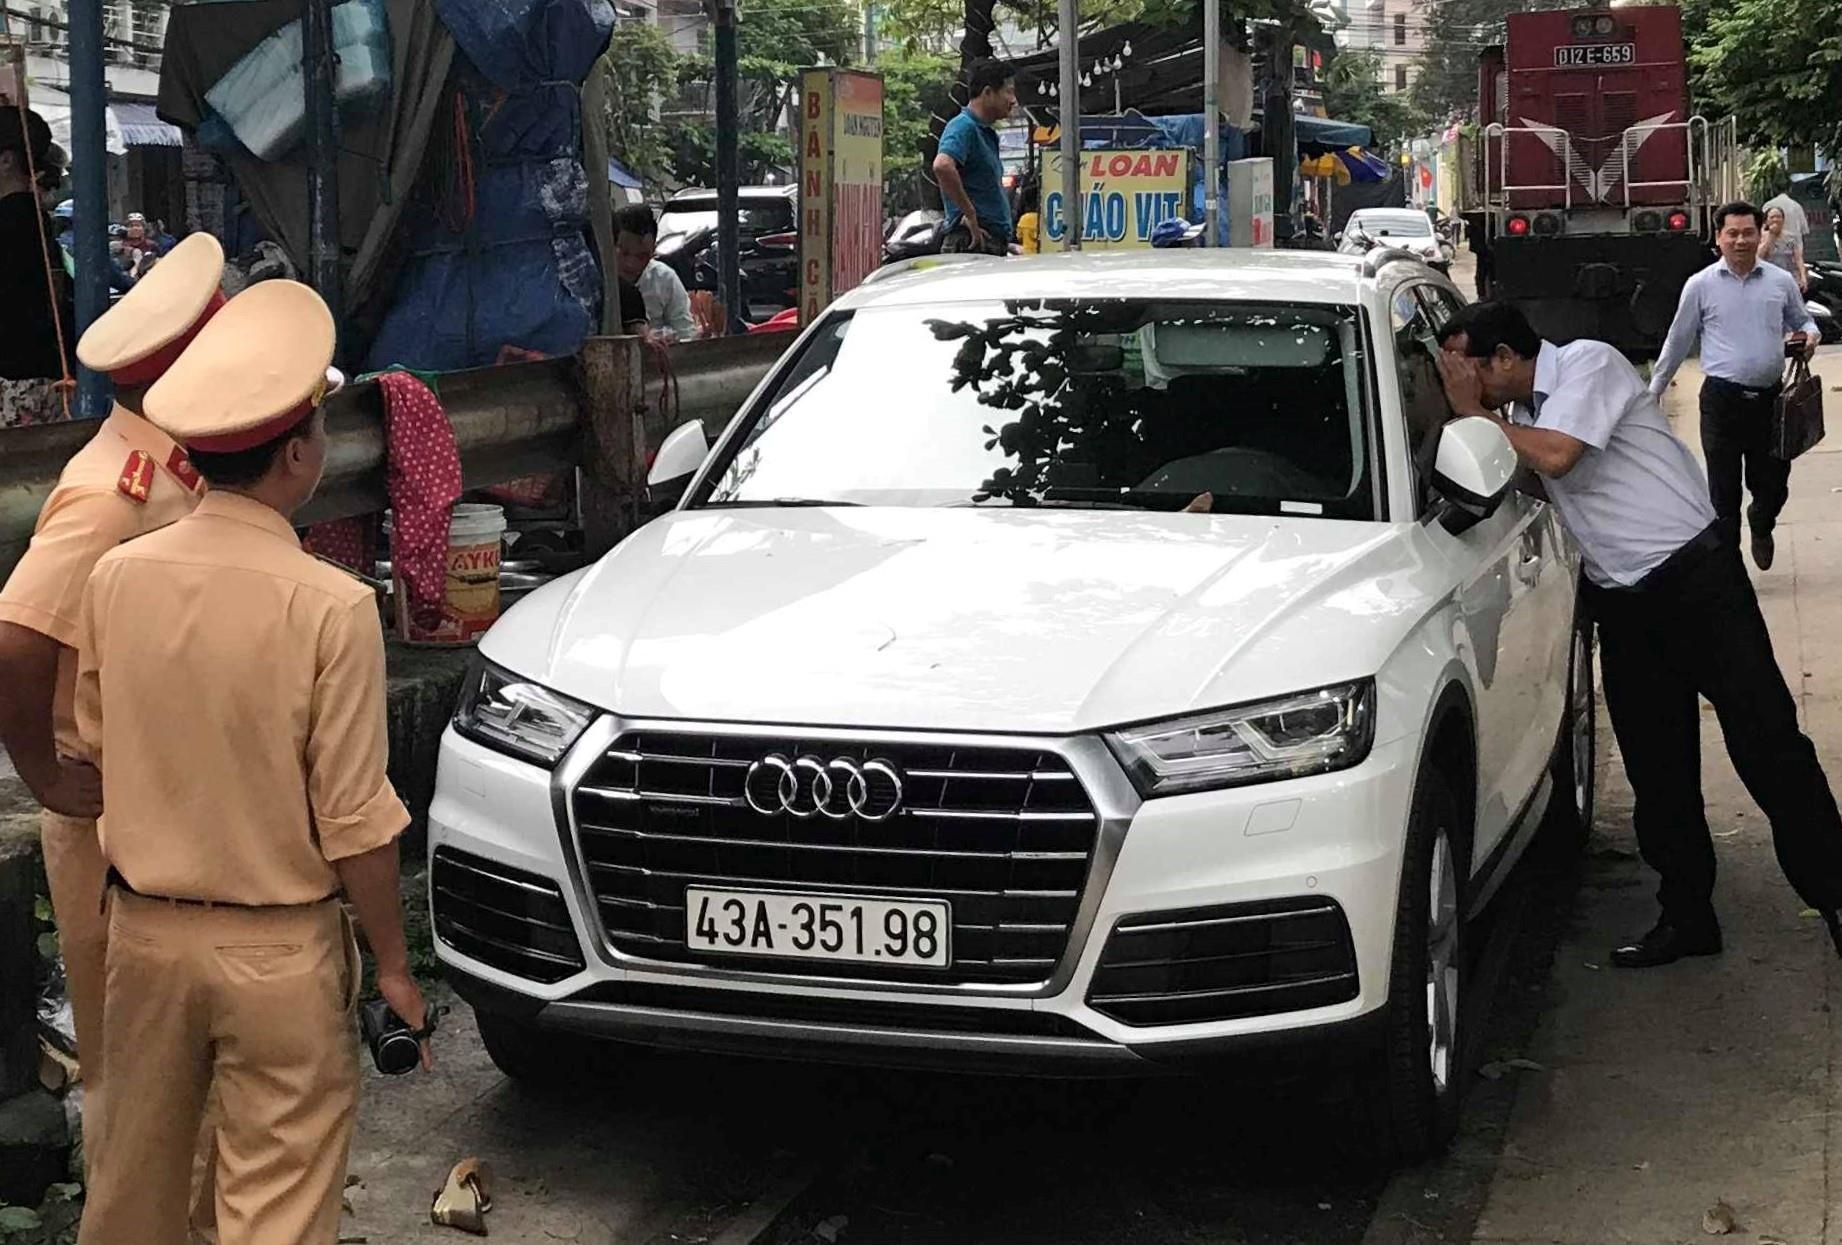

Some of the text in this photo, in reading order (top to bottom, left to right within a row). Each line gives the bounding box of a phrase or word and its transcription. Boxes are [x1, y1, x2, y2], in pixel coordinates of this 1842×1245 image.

[806, 91, 821, 236] BÁNH
[1090, 154, 1179, 177] LOAN
[1046, 182, 1126, 240] CÁO
[695, 896, 938, 959] 43A-351.98
